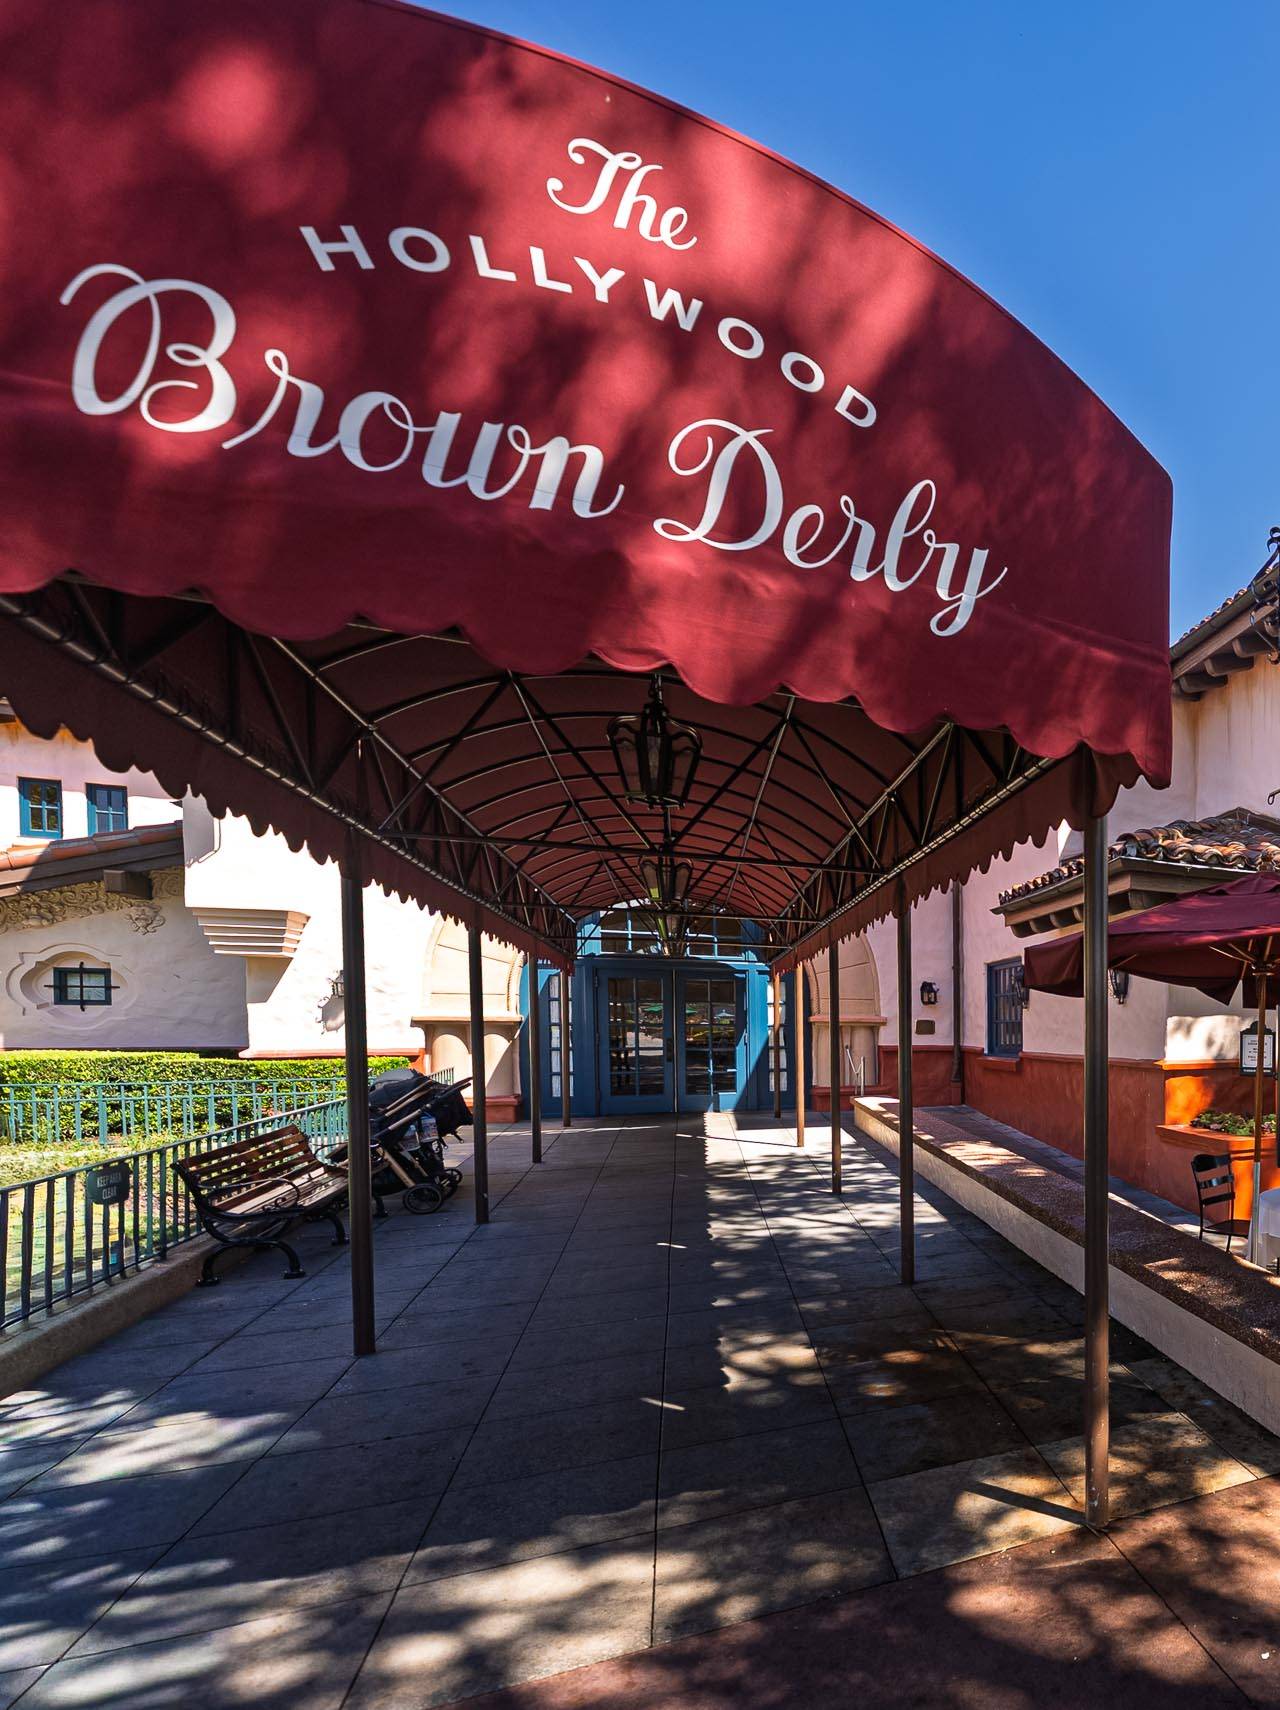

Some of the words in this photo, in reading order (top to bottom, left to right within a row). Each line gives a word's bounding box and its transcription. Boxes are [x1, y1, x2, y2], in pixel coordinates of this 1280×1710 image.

[546, 137, 698, 251] The
[300, 225, 877, 428] HOLLYWOOD
[60, 263, 625, 519] Brown
[652, 418, 1008, 637] Derby
